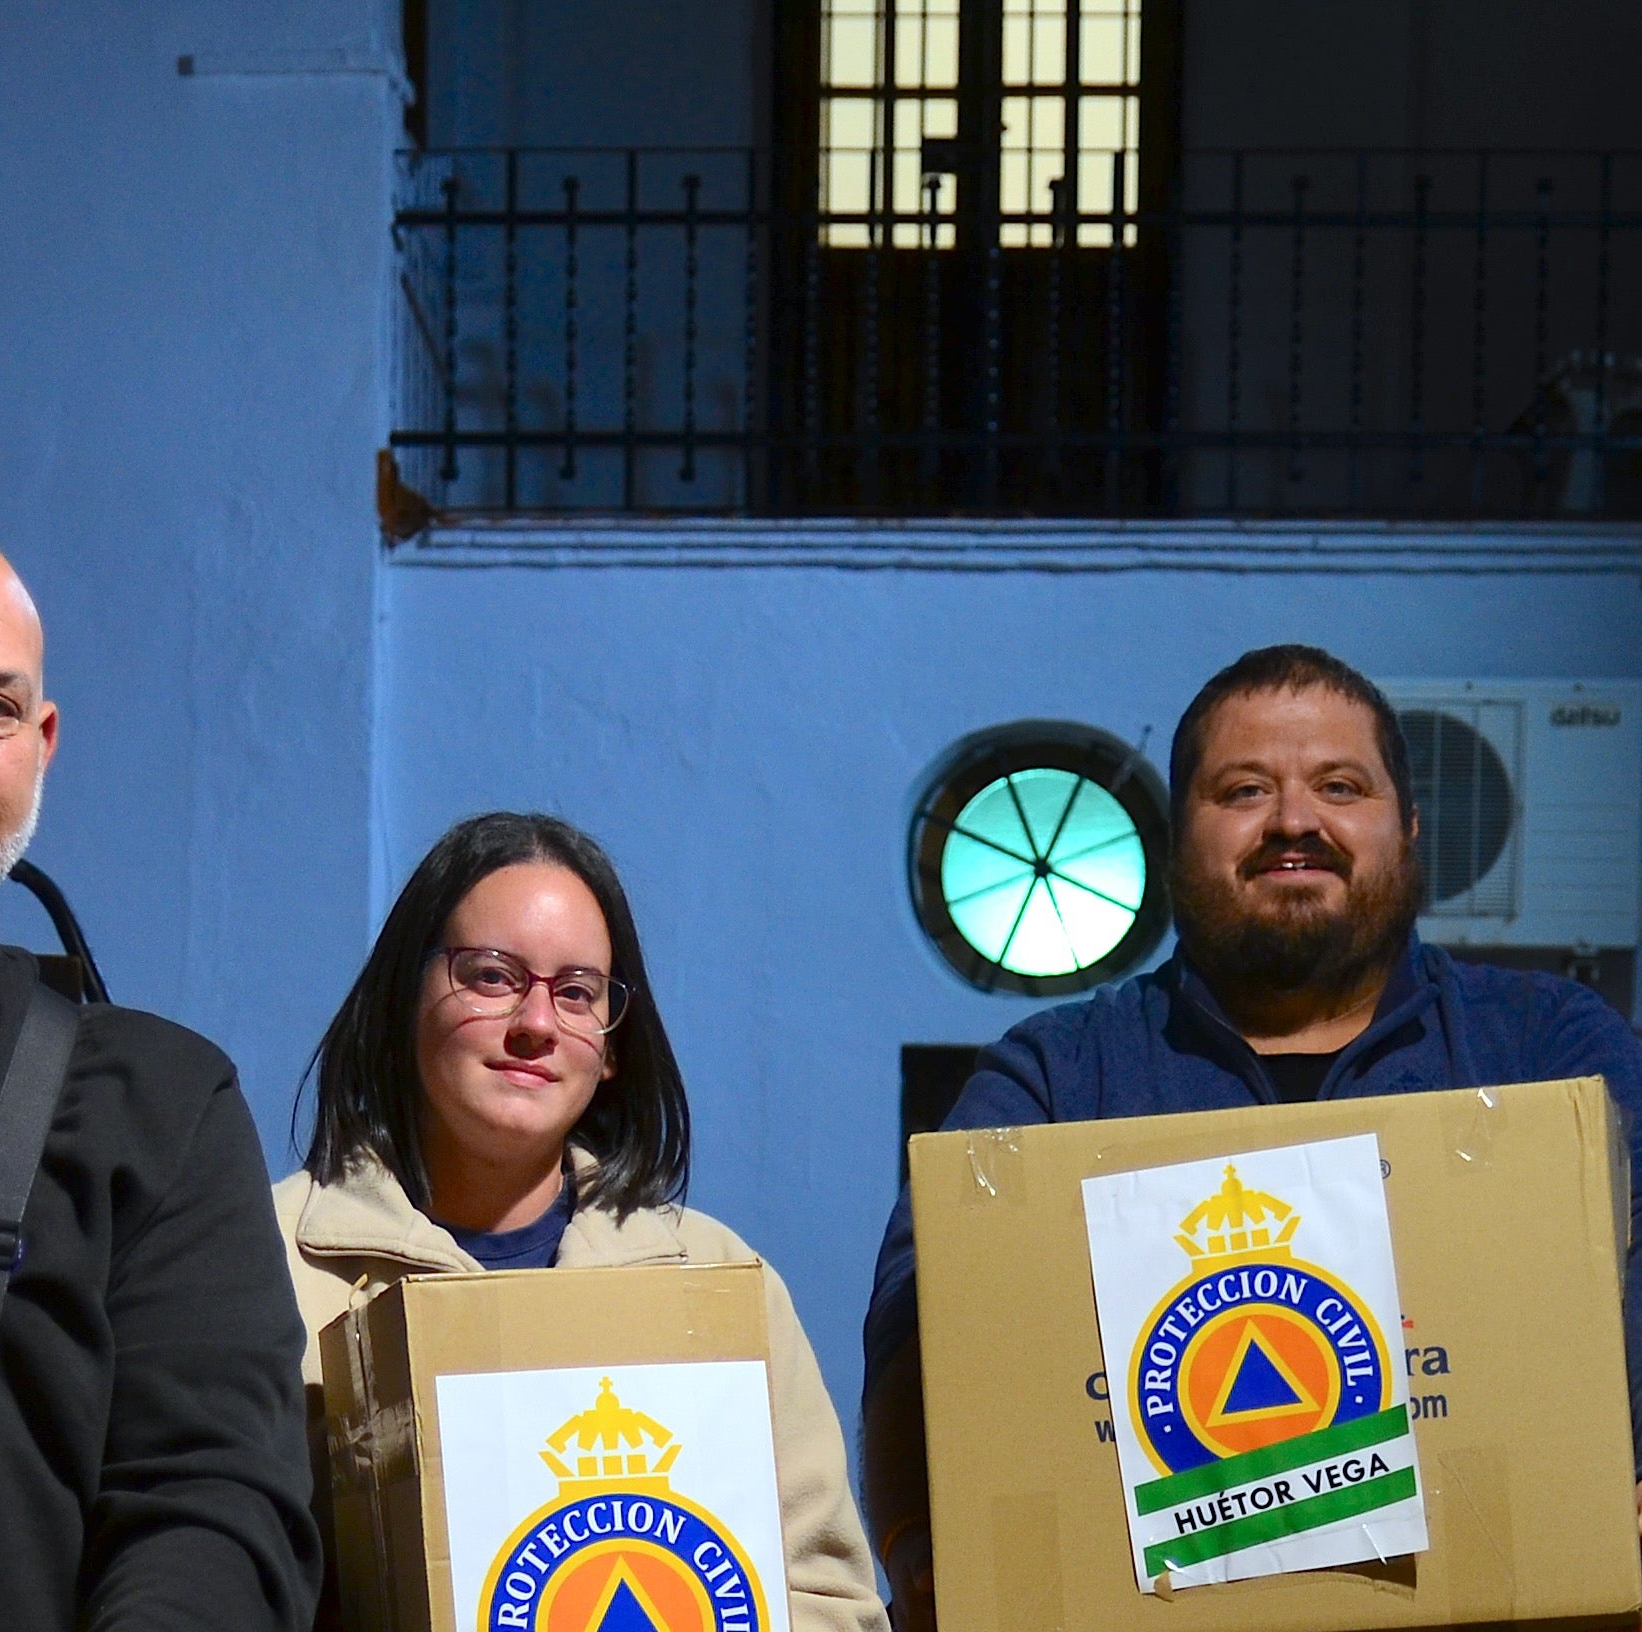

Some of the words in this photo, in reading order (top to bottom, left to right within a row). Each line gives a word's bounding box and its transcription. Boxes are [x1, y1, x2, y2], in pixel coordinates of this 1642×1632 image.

[1144, 1269, 1309, 1418] PROTECCION
[1316, 1297, 1374, 1387] CIVIL
[1173, 1479, 1295, 1534] HUÉTOR
[1302, 1452, 1390, 1496] VEGA
